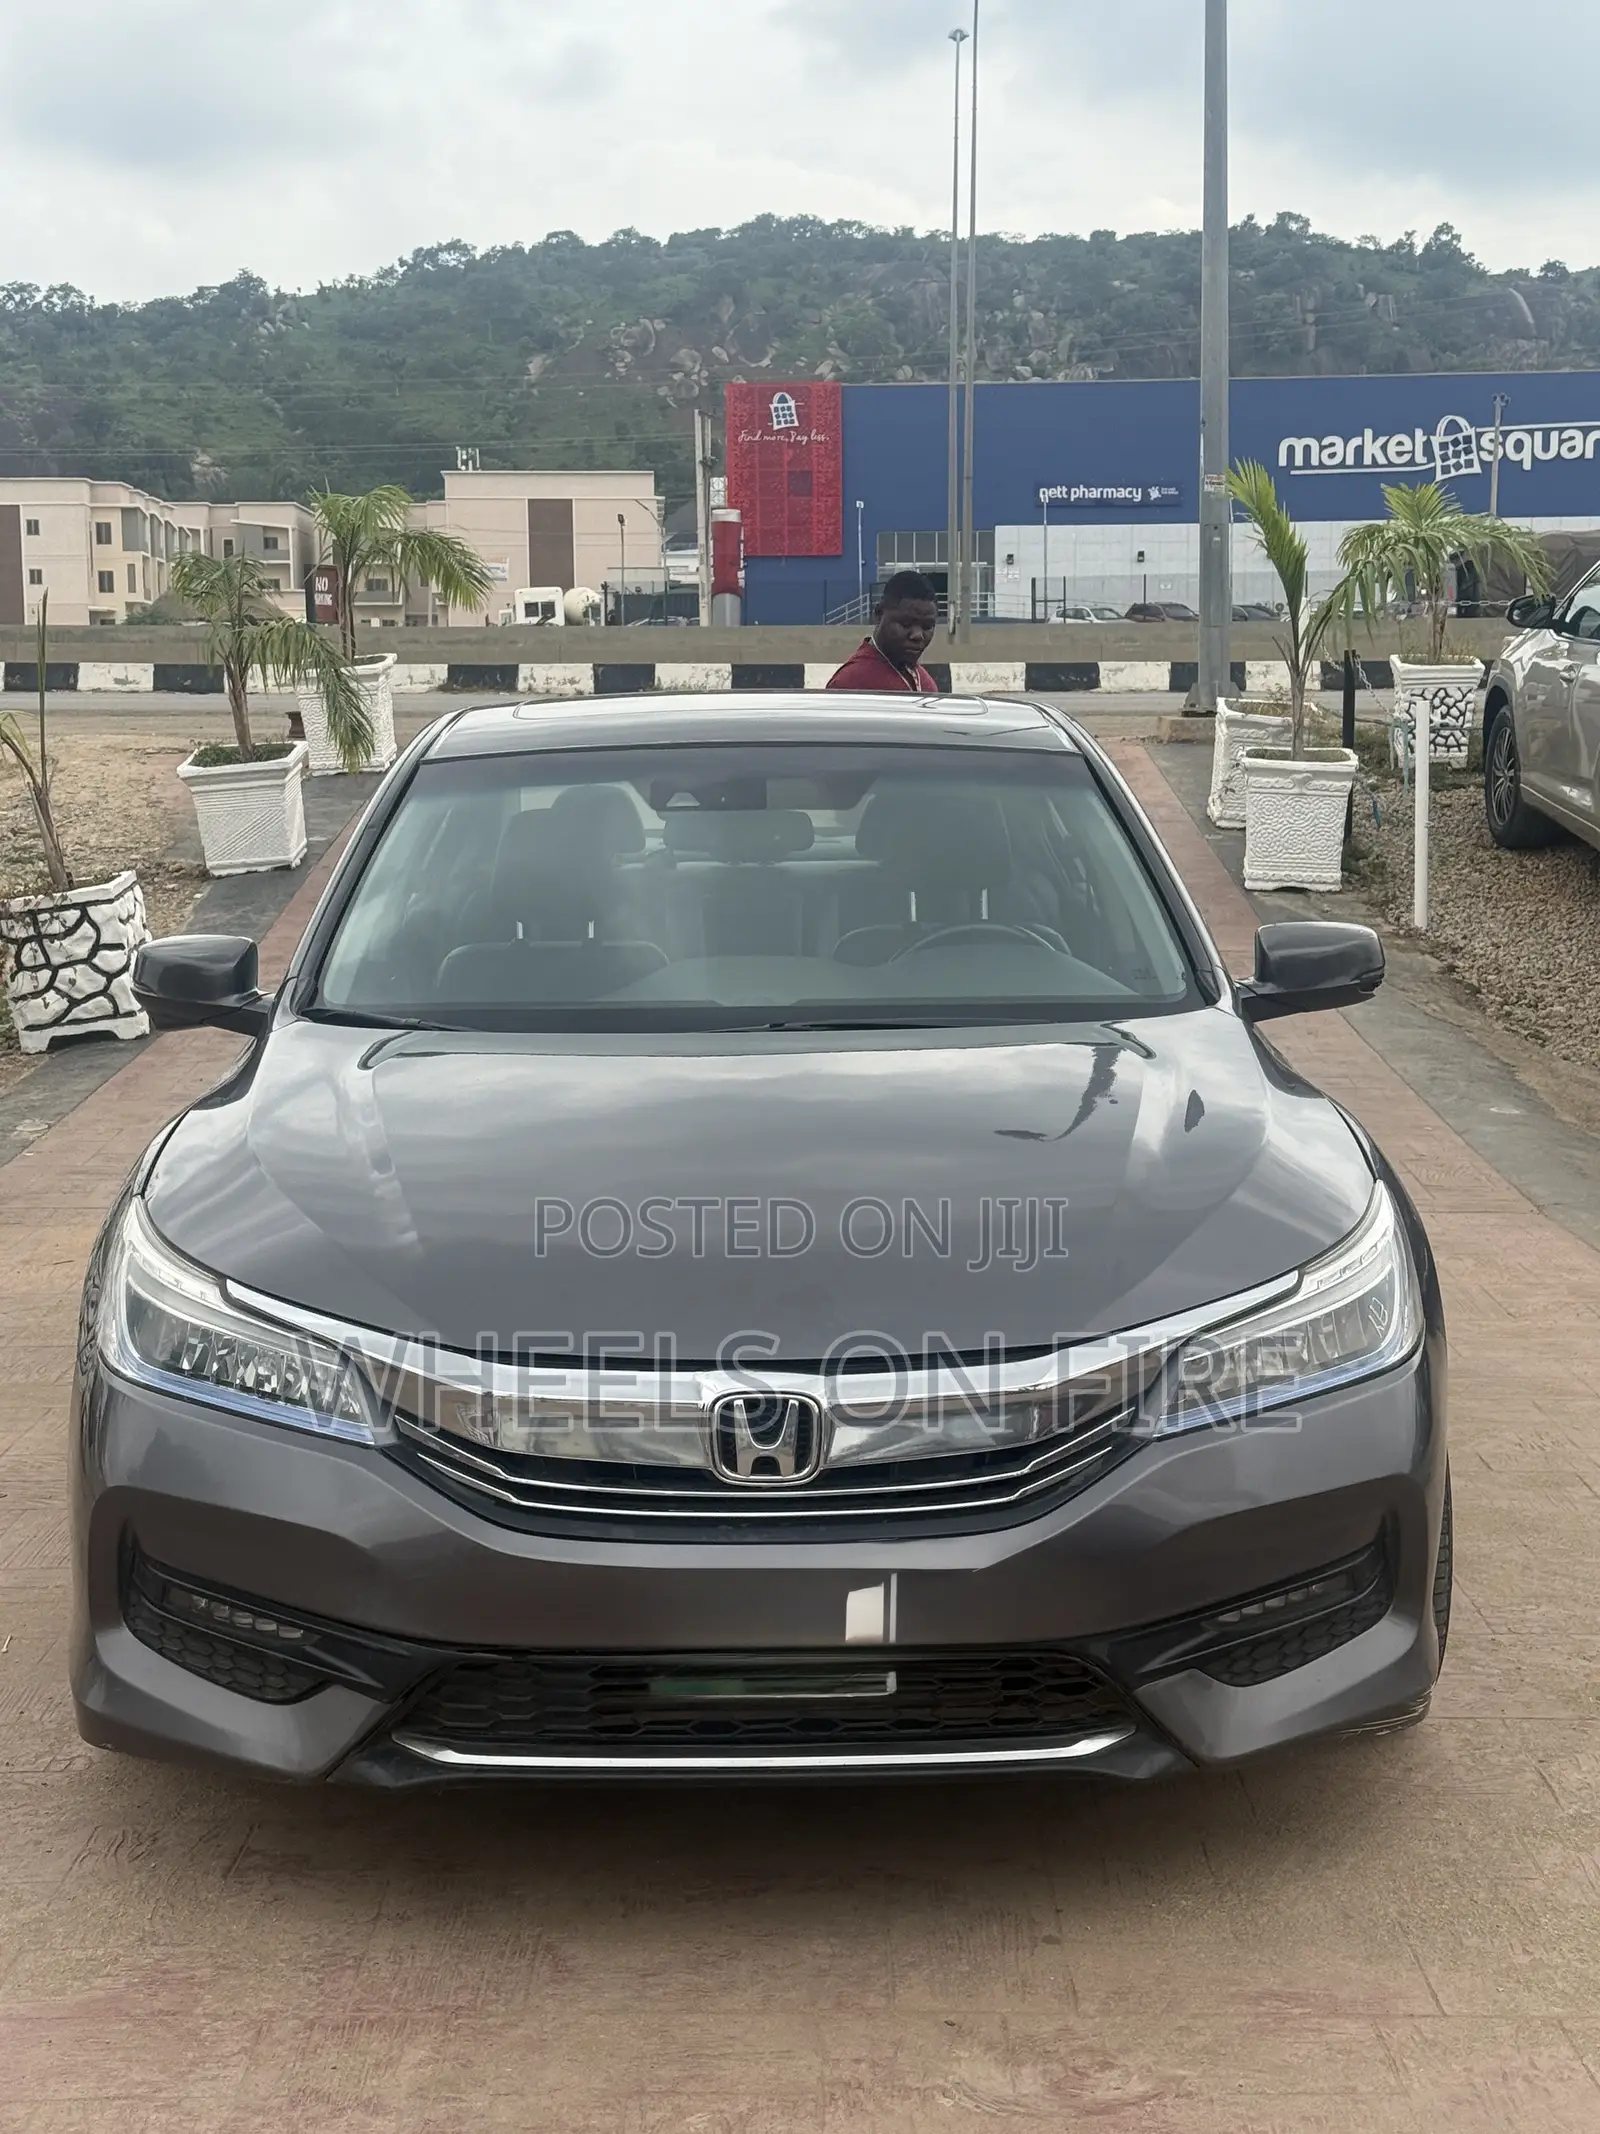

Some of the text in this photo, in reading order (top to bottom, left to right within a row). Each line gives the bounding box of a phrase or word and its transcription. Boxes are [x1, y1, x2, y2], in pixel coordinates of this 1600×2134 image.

[738, 429, 762, 442] Find
[789, 430, 808, 445] Pay
[1279, 427, 1427, 467] market
[1070, 485, 1142, 502] pharmacy
[315, 576, 329, 592] NO
